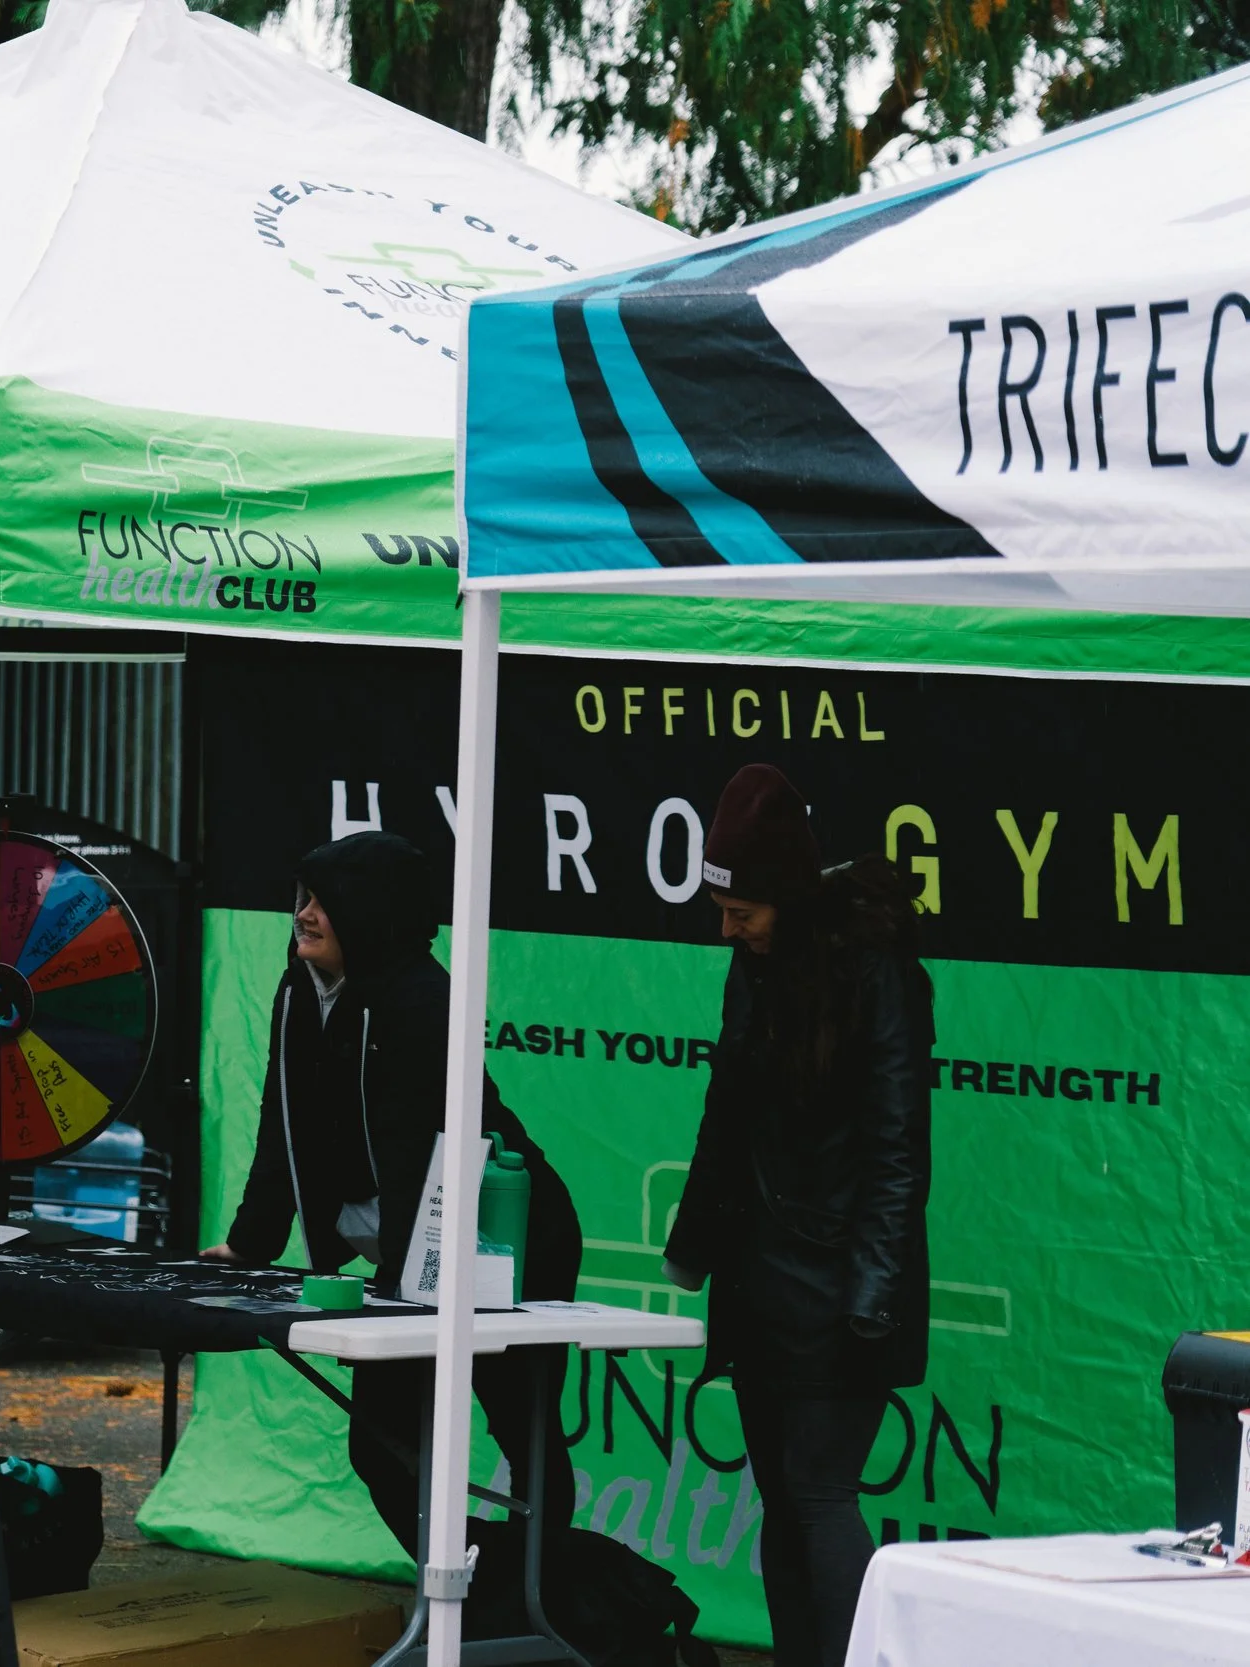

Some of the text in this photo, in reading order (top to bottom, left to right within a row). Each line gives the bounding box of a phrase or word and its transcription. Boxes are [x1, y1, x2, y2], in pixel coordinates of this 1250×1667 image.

[948, 290, 1250, 476] TRIFEC
[77, 509, 323, 575] FUNCTION
[78, 543, 318, 614] health CLUB
[575, 684, 885, 742] OFFICIAL
[884, 803, 1184, 926] GYM
[598, 1029, 717, 1070] YOUR
[36, 1068, 55, 1100] Drop
[54, 1103, 71, 1132] Free
